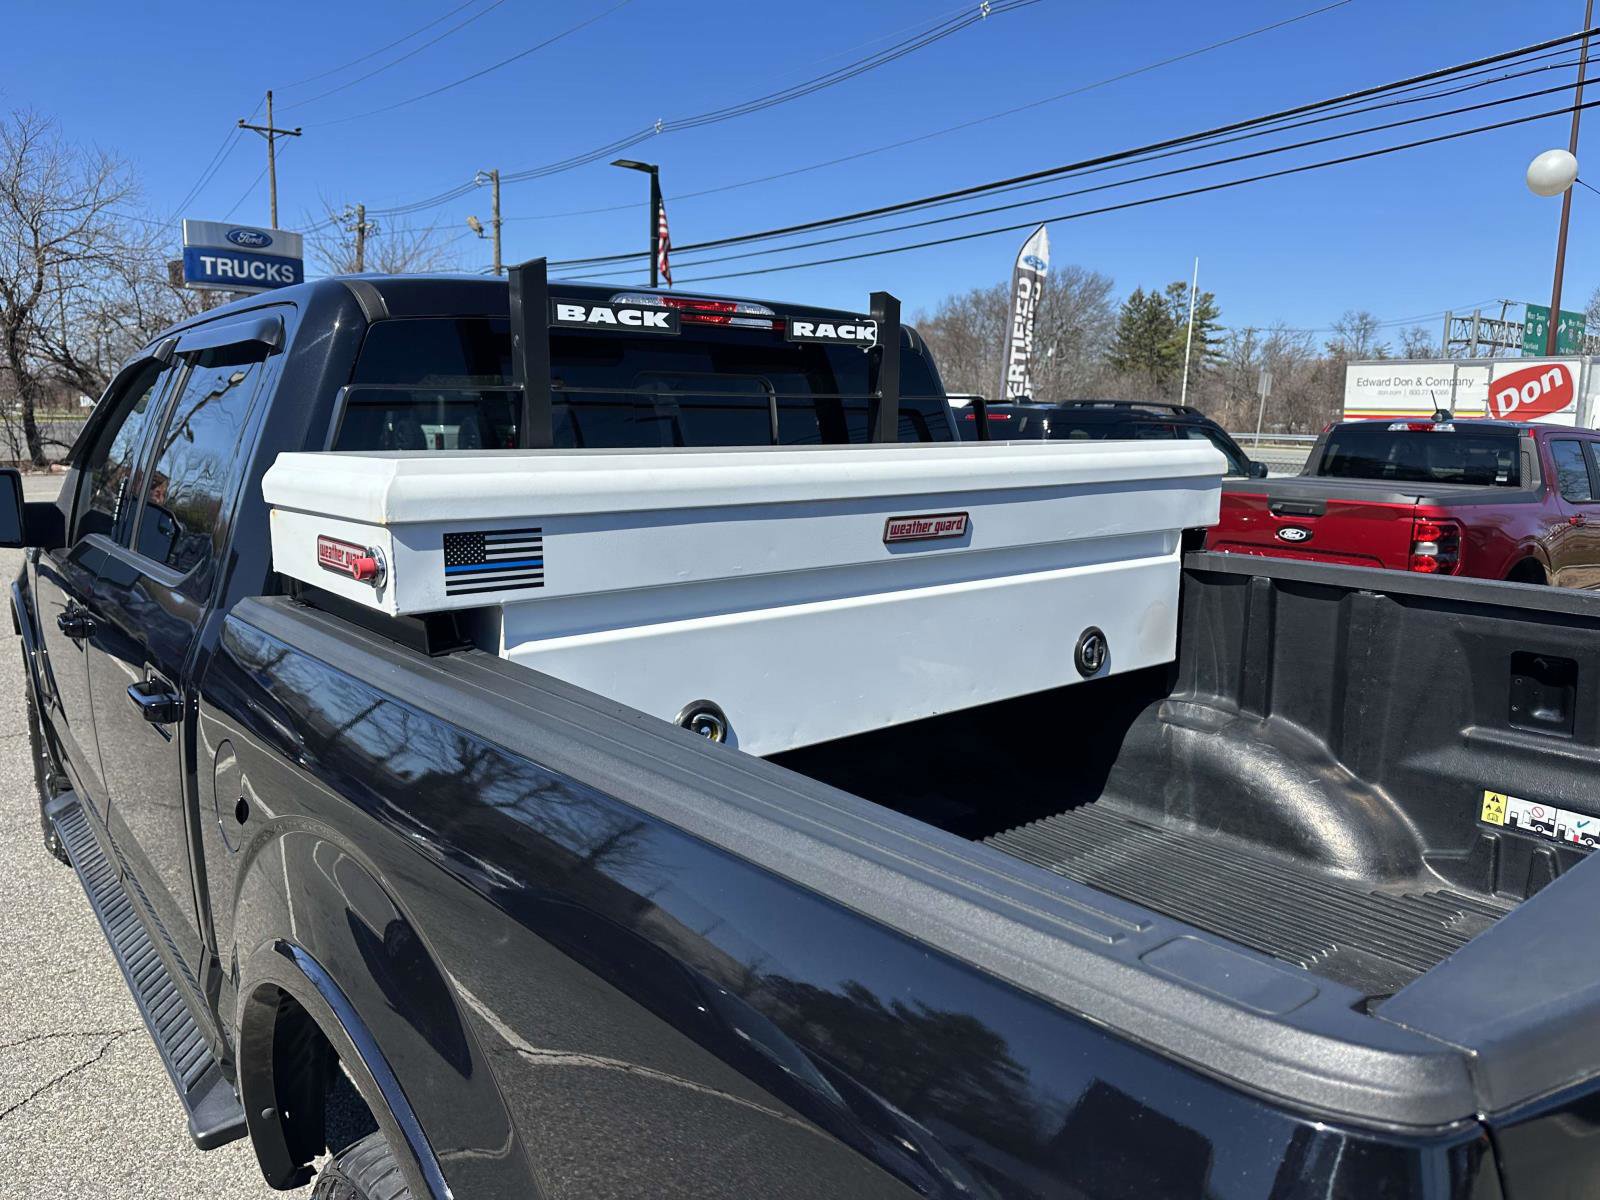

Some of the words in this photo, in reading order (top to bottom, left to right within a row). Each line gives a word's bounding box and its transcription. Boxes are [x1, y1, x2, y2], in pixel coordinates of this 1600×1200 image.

[237, 231, 264, 245] Ford
[200, 255, 295, 284] TRUCKS
[557, 304, 670, 328] BACK
[794, 321, 876, 341] RACK
[1006, 277, 1031, 398] ERTIFIED
[1356, 377, 1392, 388] Edward
[1393, 377, 1413, 387] Don
[1415, 377, 1423, 387] &
[1425, 376, 1475, 389] Company
[1495, 368, 1563, 417] Don
[890, 521, 933, 535] weather
[934, 517, 963, 534] guard
[320, 543, 344, 562] weather
